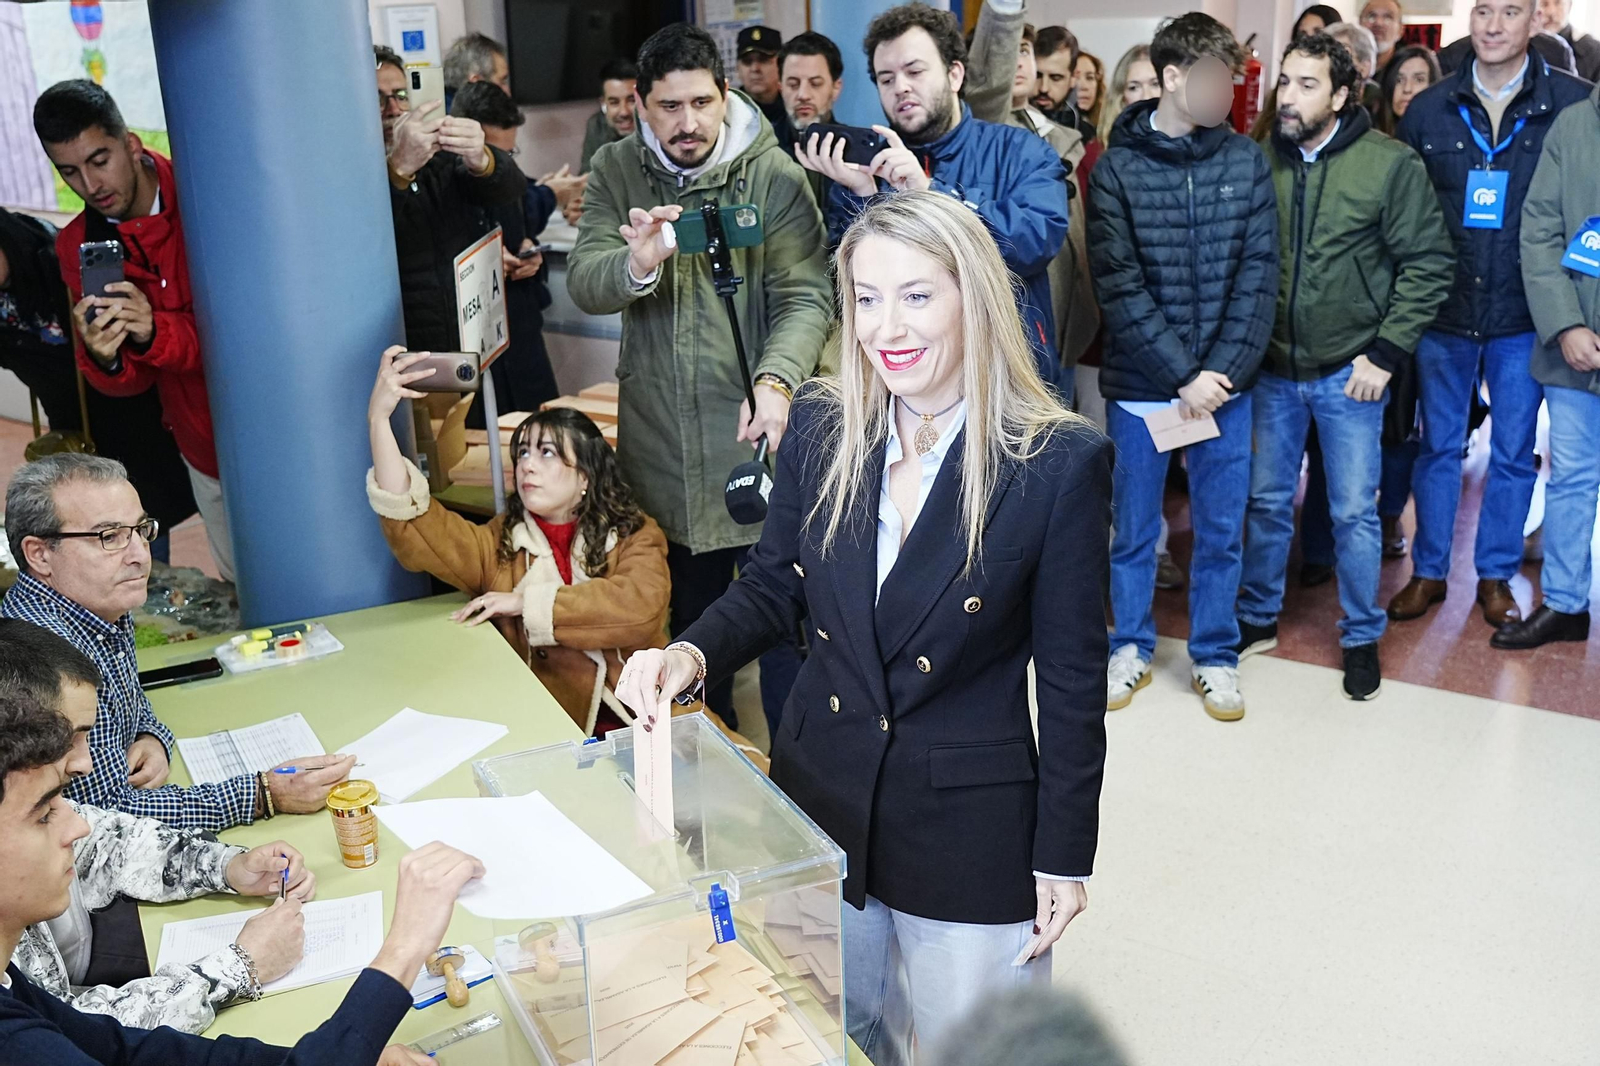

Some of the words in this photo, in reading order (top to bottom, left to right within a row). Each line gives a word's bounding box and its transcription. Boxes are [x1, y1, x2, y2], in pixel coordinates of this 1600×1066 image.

[492, 269, 500, 299] A
[463, 295, 482, 325] MESA
[496, 321, 503, 341] K
[725, 475, 756, 493] EDATV
